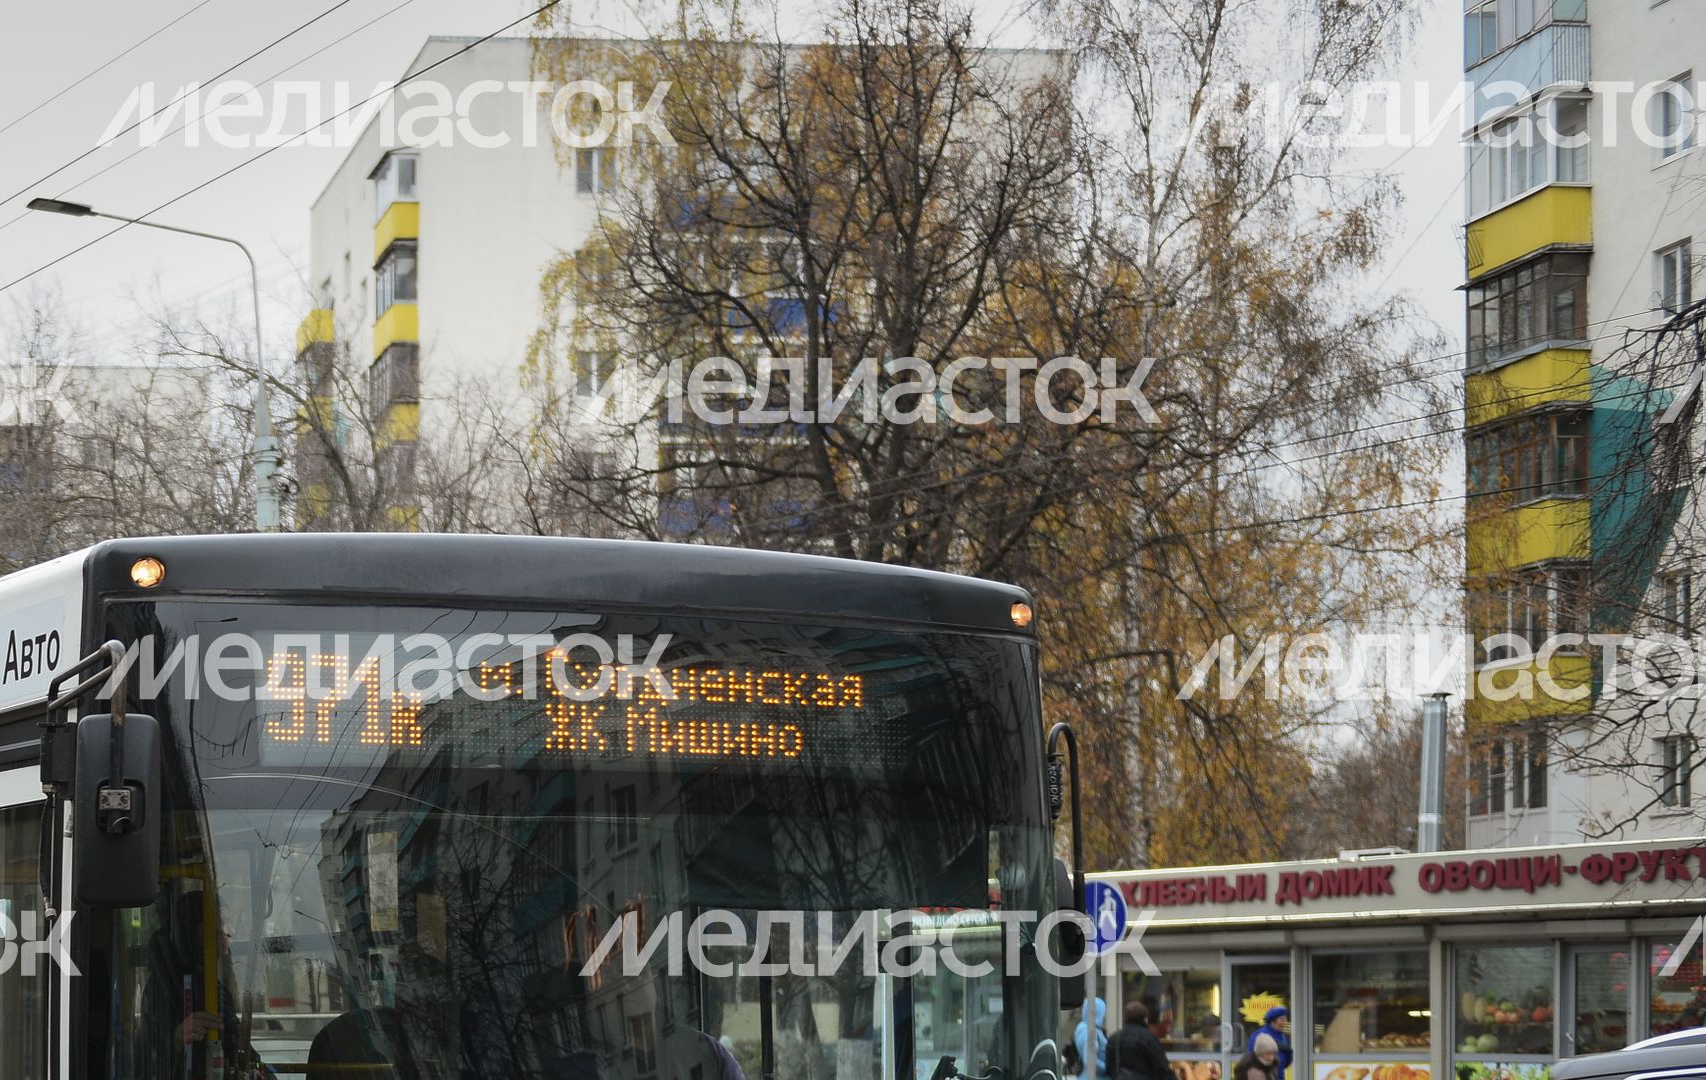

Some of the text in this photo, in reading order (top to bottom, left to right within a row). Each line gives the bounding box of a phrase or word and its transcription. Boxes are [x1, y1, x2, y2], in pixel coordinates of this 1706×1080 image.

[3, 629, 60, 685] Авто
[544, 702, 805, 758] ЖК Мишино
[1275, 865, 1395, 905] ДОМИК
